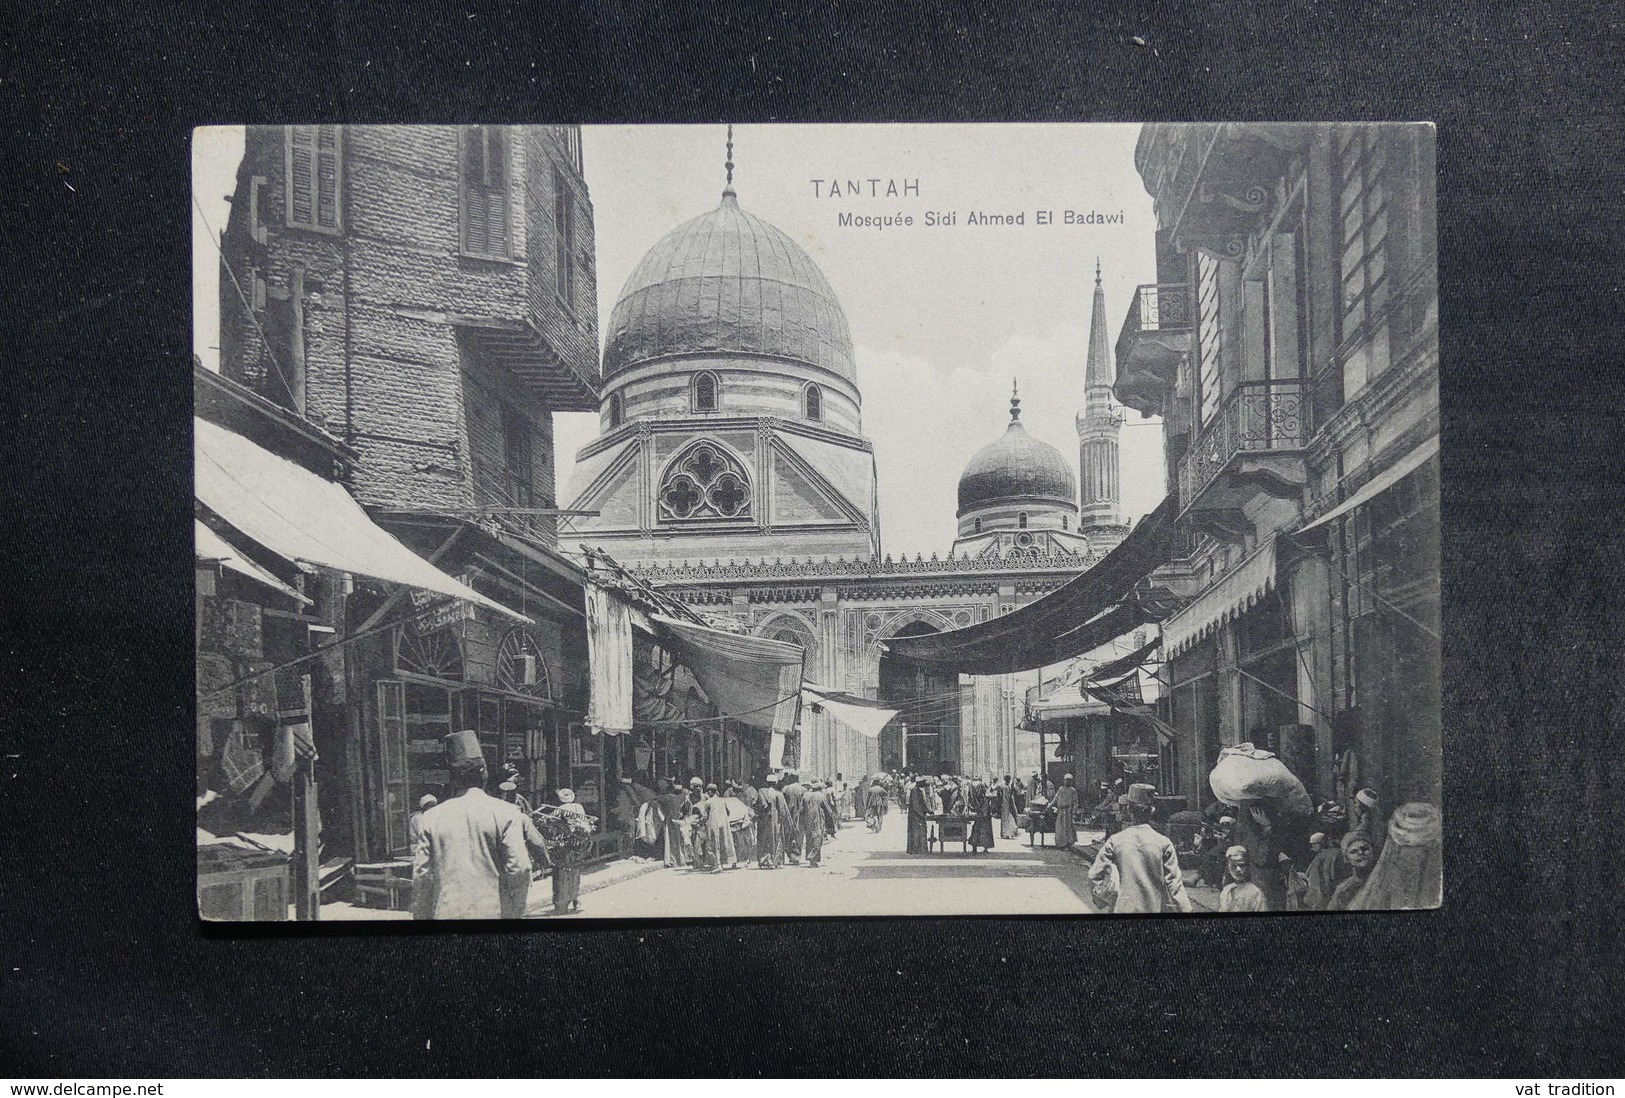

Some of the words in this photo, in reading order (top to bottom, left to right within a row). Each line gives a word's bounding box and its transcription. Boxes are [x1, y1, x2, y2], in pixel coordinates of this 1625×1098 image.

[811, 178, 920, 199] TANTAH
[838, 211, 914, 231] Mosquée
[924, 211, 957, 227] Sidi
[967, 210, 1025, 226] Ahmed
[1036, 210, 1053, 225] El
[1064, 210, 1125, 225] Badawi
